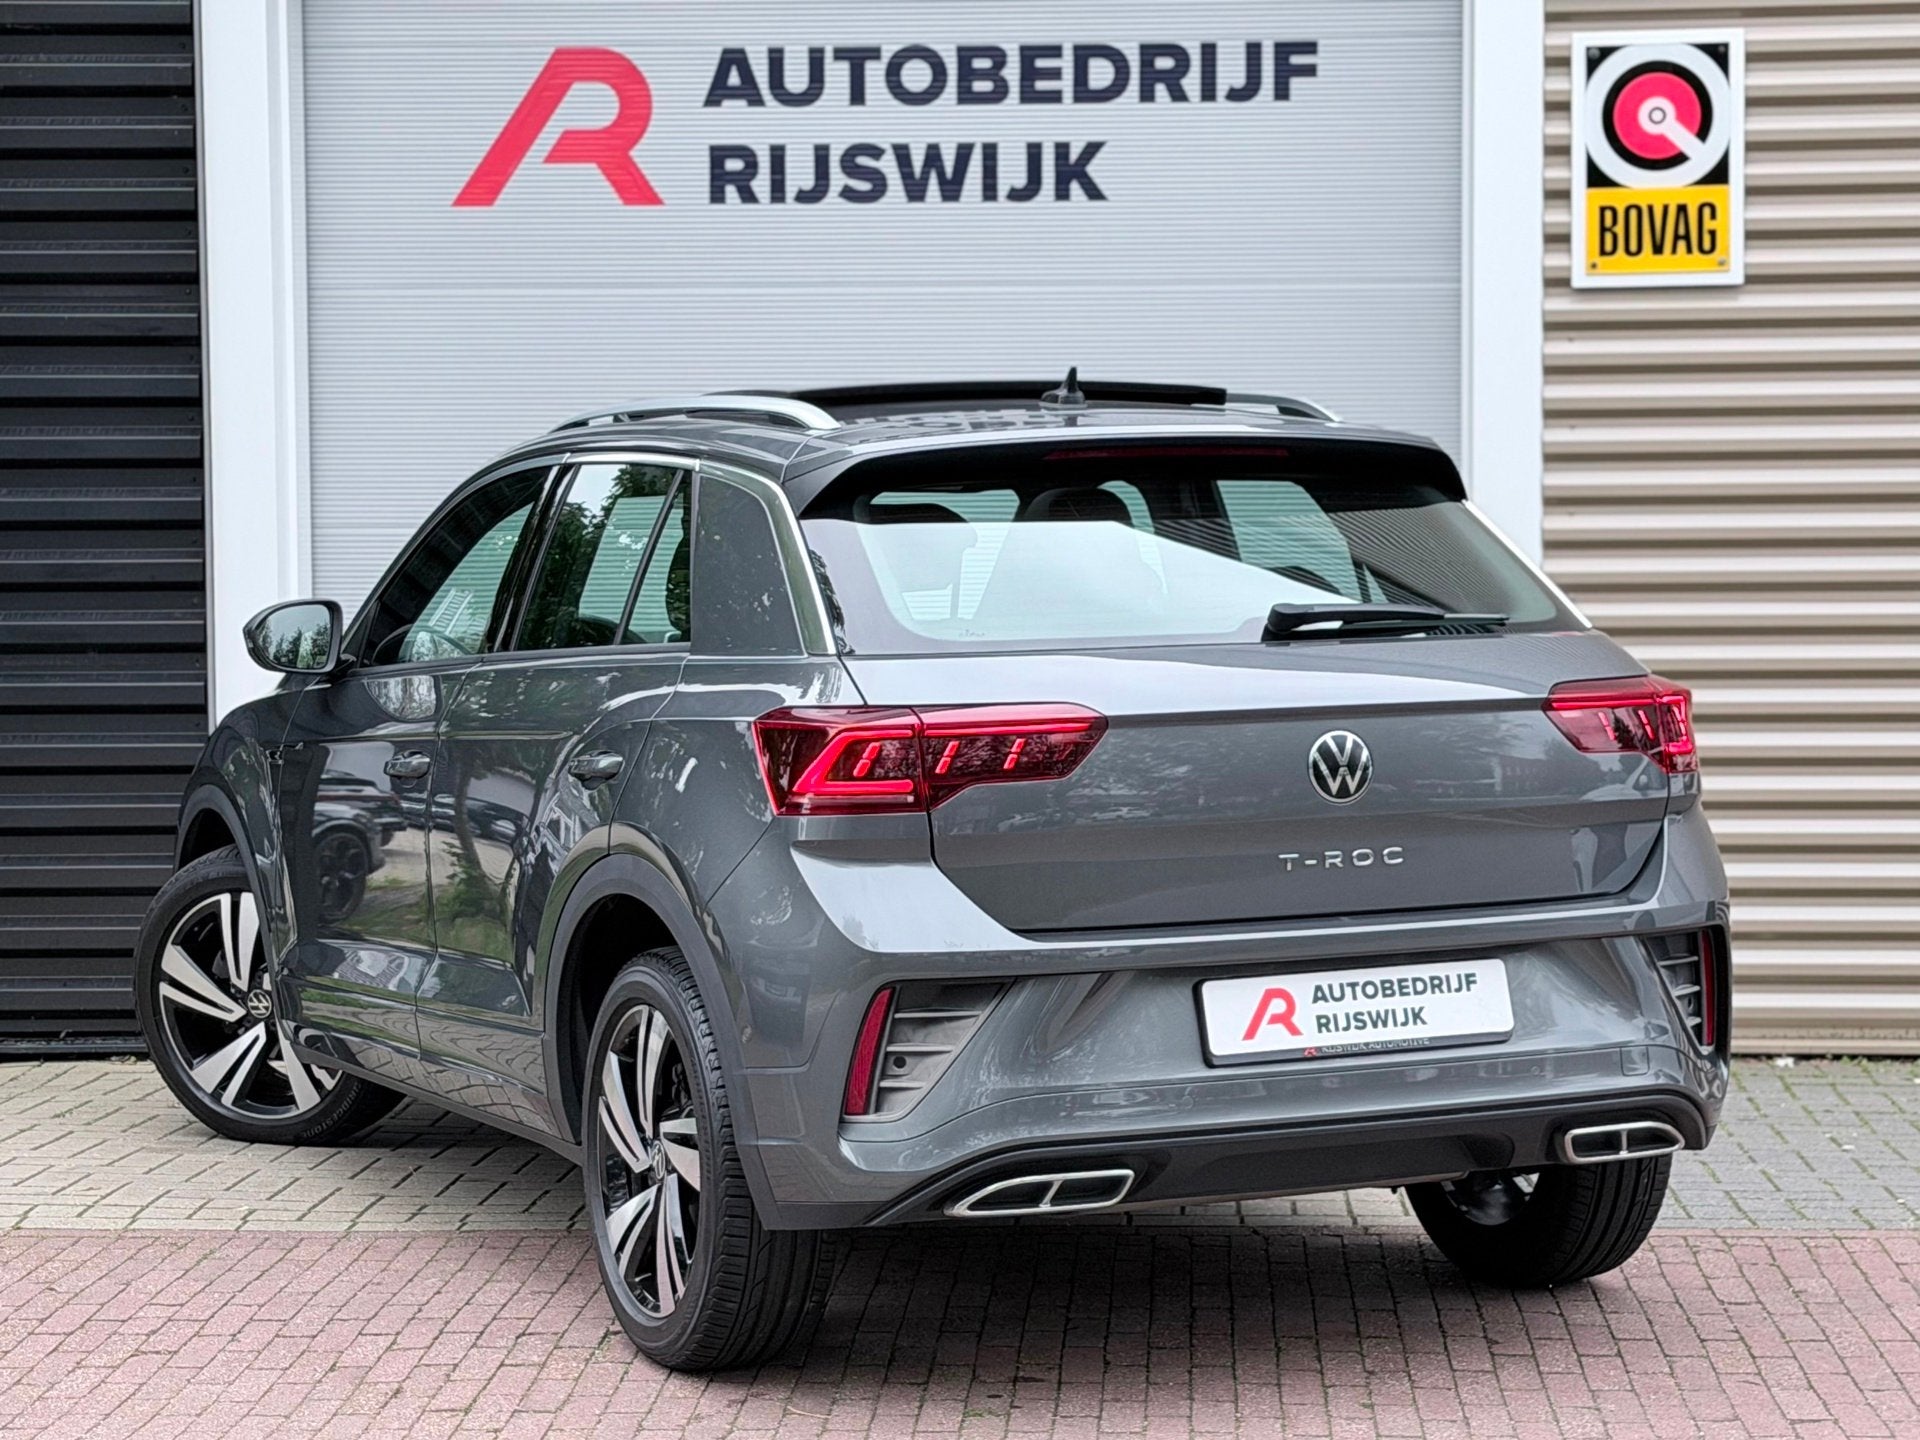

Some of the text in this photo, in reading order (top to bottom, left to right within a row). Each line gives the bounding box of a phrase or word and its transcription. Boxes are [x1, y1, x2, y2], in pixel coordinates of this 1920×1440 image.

[703, 41, 1319, 108] AUTOBEDRIJF
[709, 141, 1108, 204] RIJSWIJK
[1599, 202, 1717, 257] BOVAG
[1278, 847, 1404, 871] T-ROC
[1311, 972, 1478, 1004] AUTOBEDRIJF
[1315, 1006, 1428, 1034] RIJSWIJK
